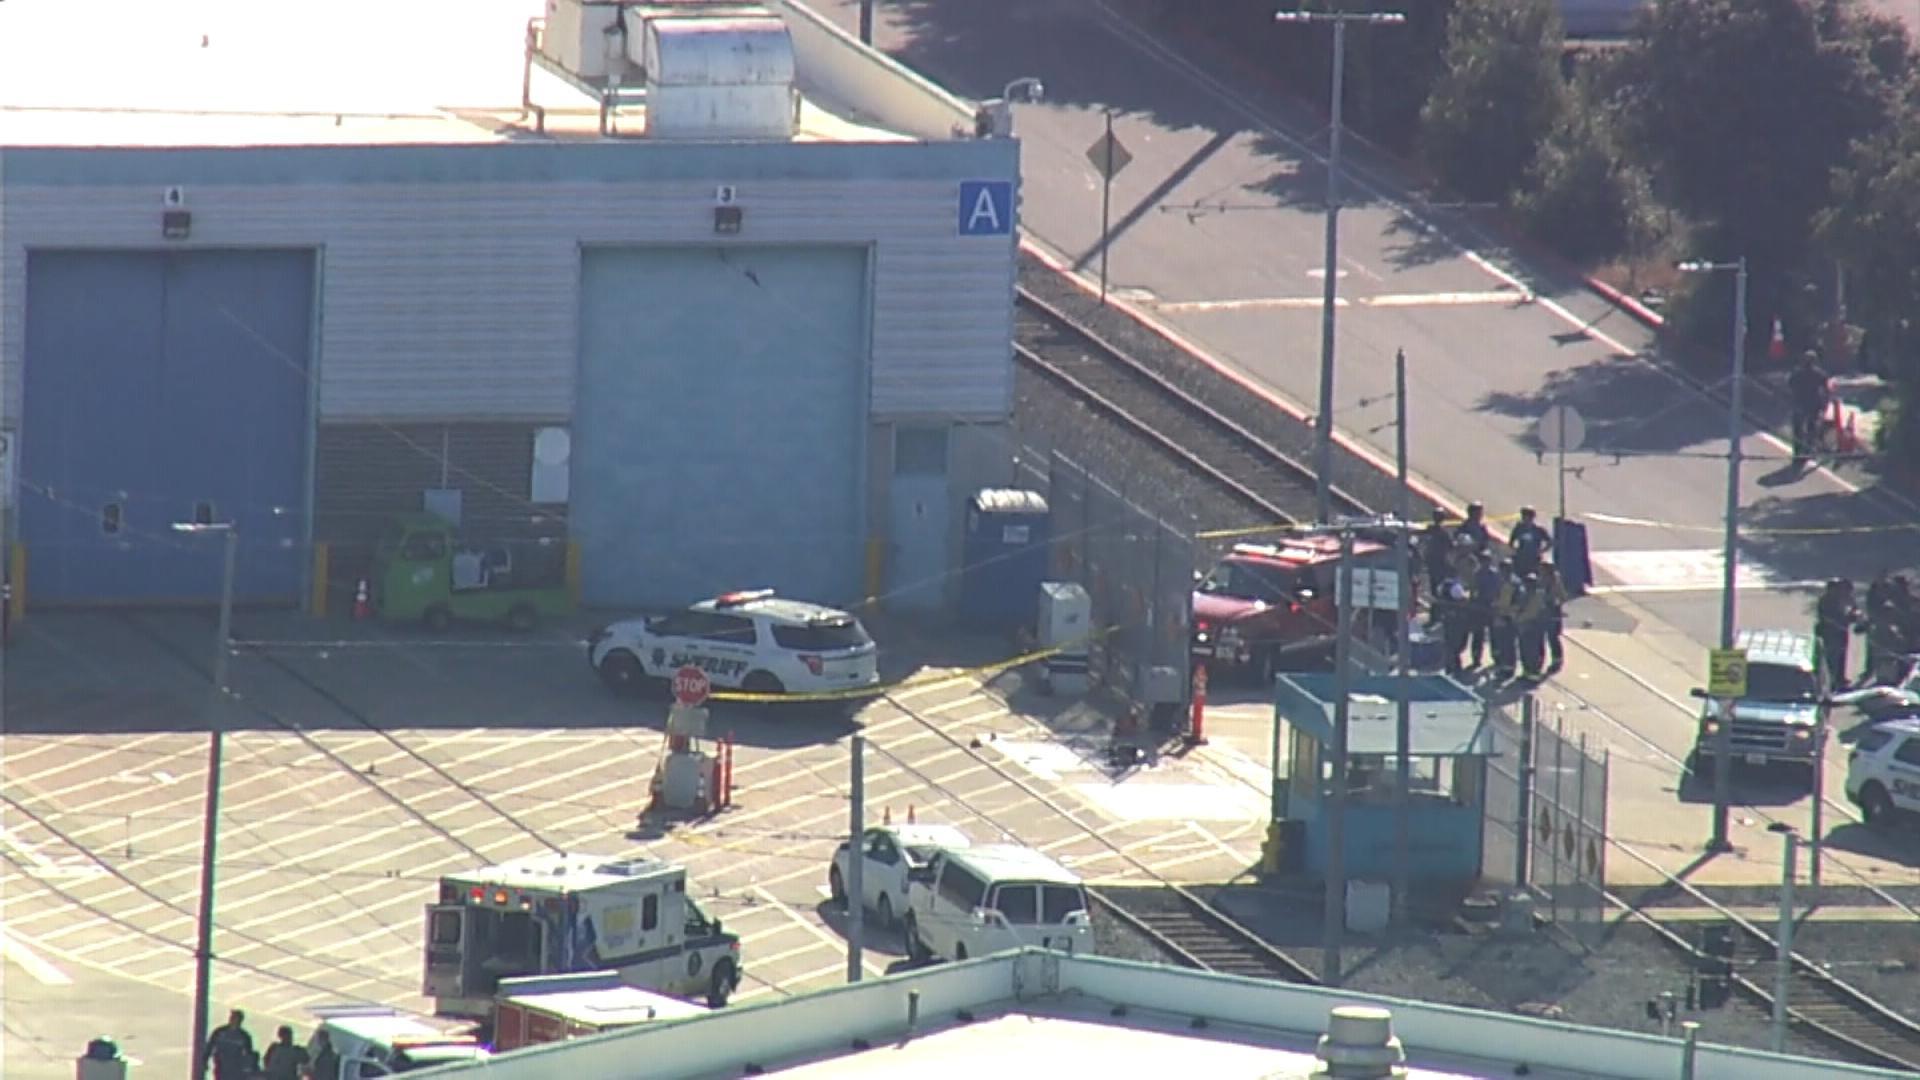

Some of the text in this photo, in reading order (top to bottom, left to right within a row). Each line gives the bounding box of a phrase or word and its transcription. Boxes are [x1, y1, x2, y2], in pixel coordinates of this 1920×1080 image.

[168, 187, 180, 203] 4
[720, 187, 732, 202] 3
[968, 187, 999, 230] A
[669, 652, 749, 678] SHERIFF
[674, 677, 706, 692] STOP
